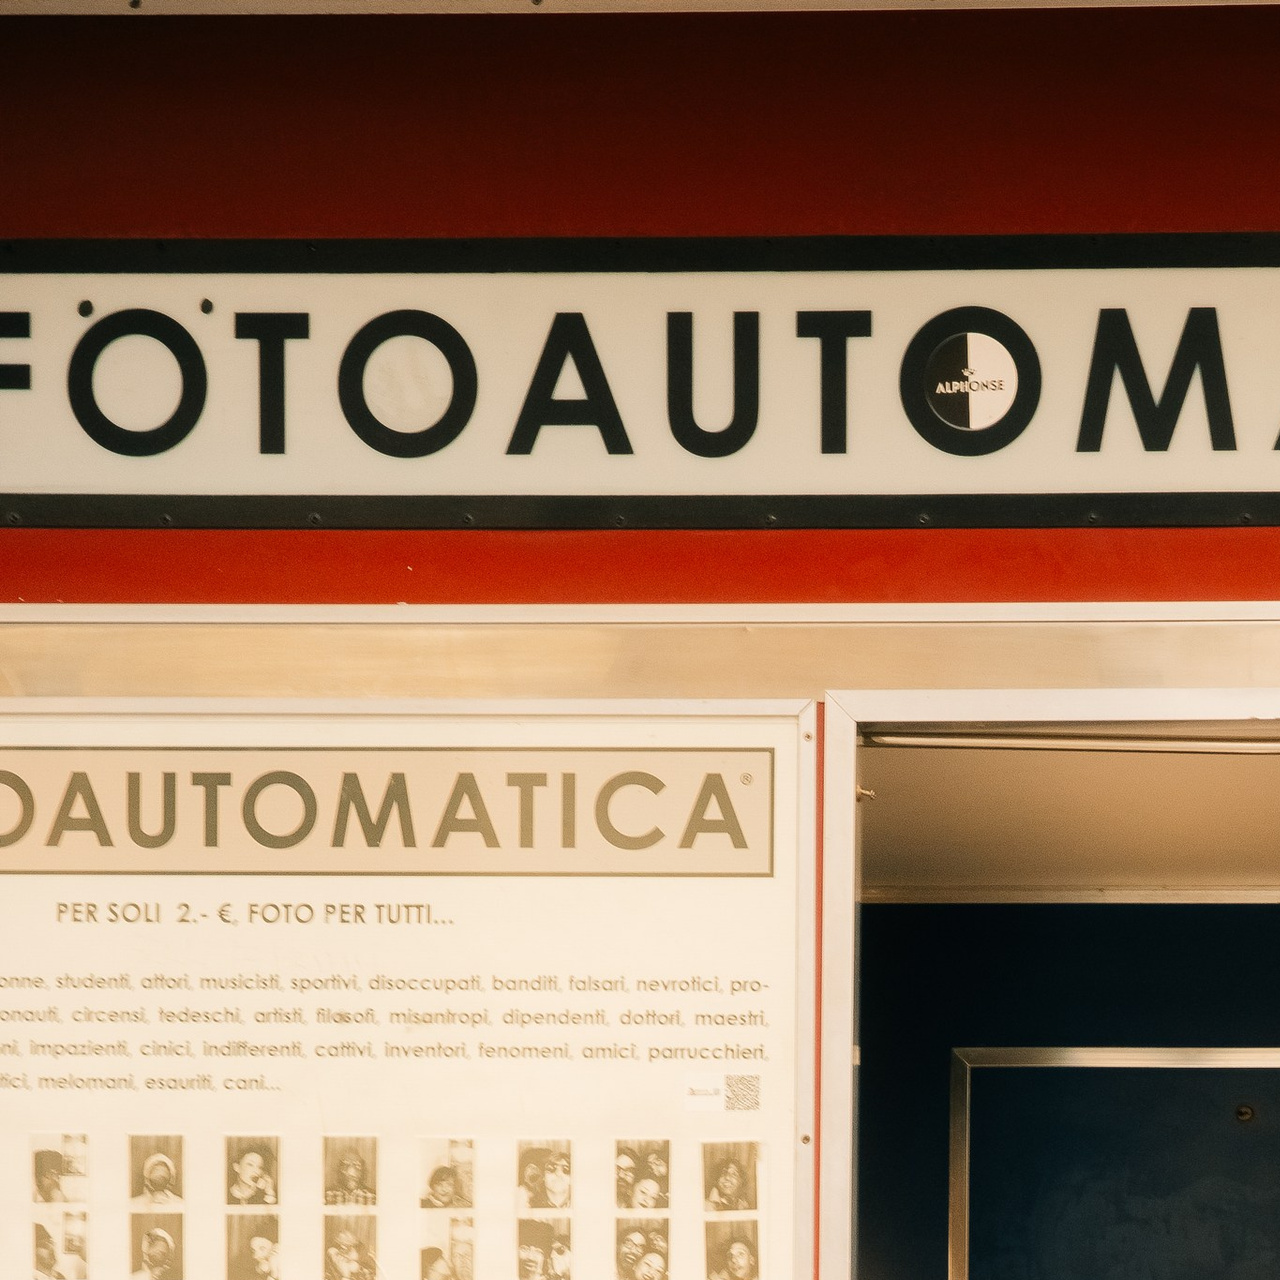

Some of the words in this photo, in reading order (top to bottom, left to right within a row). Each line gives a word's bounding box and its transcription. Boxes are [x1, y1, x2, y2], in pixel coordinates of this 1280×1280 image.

[935, 380, 1005, 394] ALPHONSE
[56, 903, 98, 925] PER
[106, 903, 162, 925] SOLI
[248, 903, 315, 926] FOTO
[324, 904, 366, 926] PER
[374, 904, 455, 926] TUTTI...
[56, 973, 134, 992] studenti,
[140, 973, 193, 992] attori,
[199, 974, 285, 992] musicisti,
[290, 975, 362, 996] sportivi,
[368, 975, 485, 997] disoccupati,
[492, 976, 562, 994] banditi,
[568, 976, 630, 994] falsari,
[636, 977, 724, 995] nevrotici,
[730, 979, 769, 998] pro-
[71, 1006, 150, 1025] circensi,
[158, 1007, 245, 1026] tedeschi,
[254, 1008, 308, 1026] artisti,
[315, 1008, 379, 1026] filosofi,
[389, 1009, 492, 1030] misantropi,
[502, 1009, 609, 1030] dipendenti,
[619, 1010, 685, 1028] dottori,
[694, 1011, 769, 1029] maestri,
[29, 1039, 132, 1060] impazienti,
[139, 1041, 195, 1059] cinici,
[203, 1041, 307, 1060] indifferenti,
[314, 1042, 376, 1060] cattivi,
[384, 1042, 471, 1061] inventori,
[478, 1043, 573, 1061] fenomeni,
[581, 1044, 640, 1061] amici,
[648, 1044, 769, 1064] parrucchieri,
[37, 1074, 138, 1092] melomani,
[144, 1074, 217, 1092] esauriti,
[223, 1075, 281, 1092] cani...
